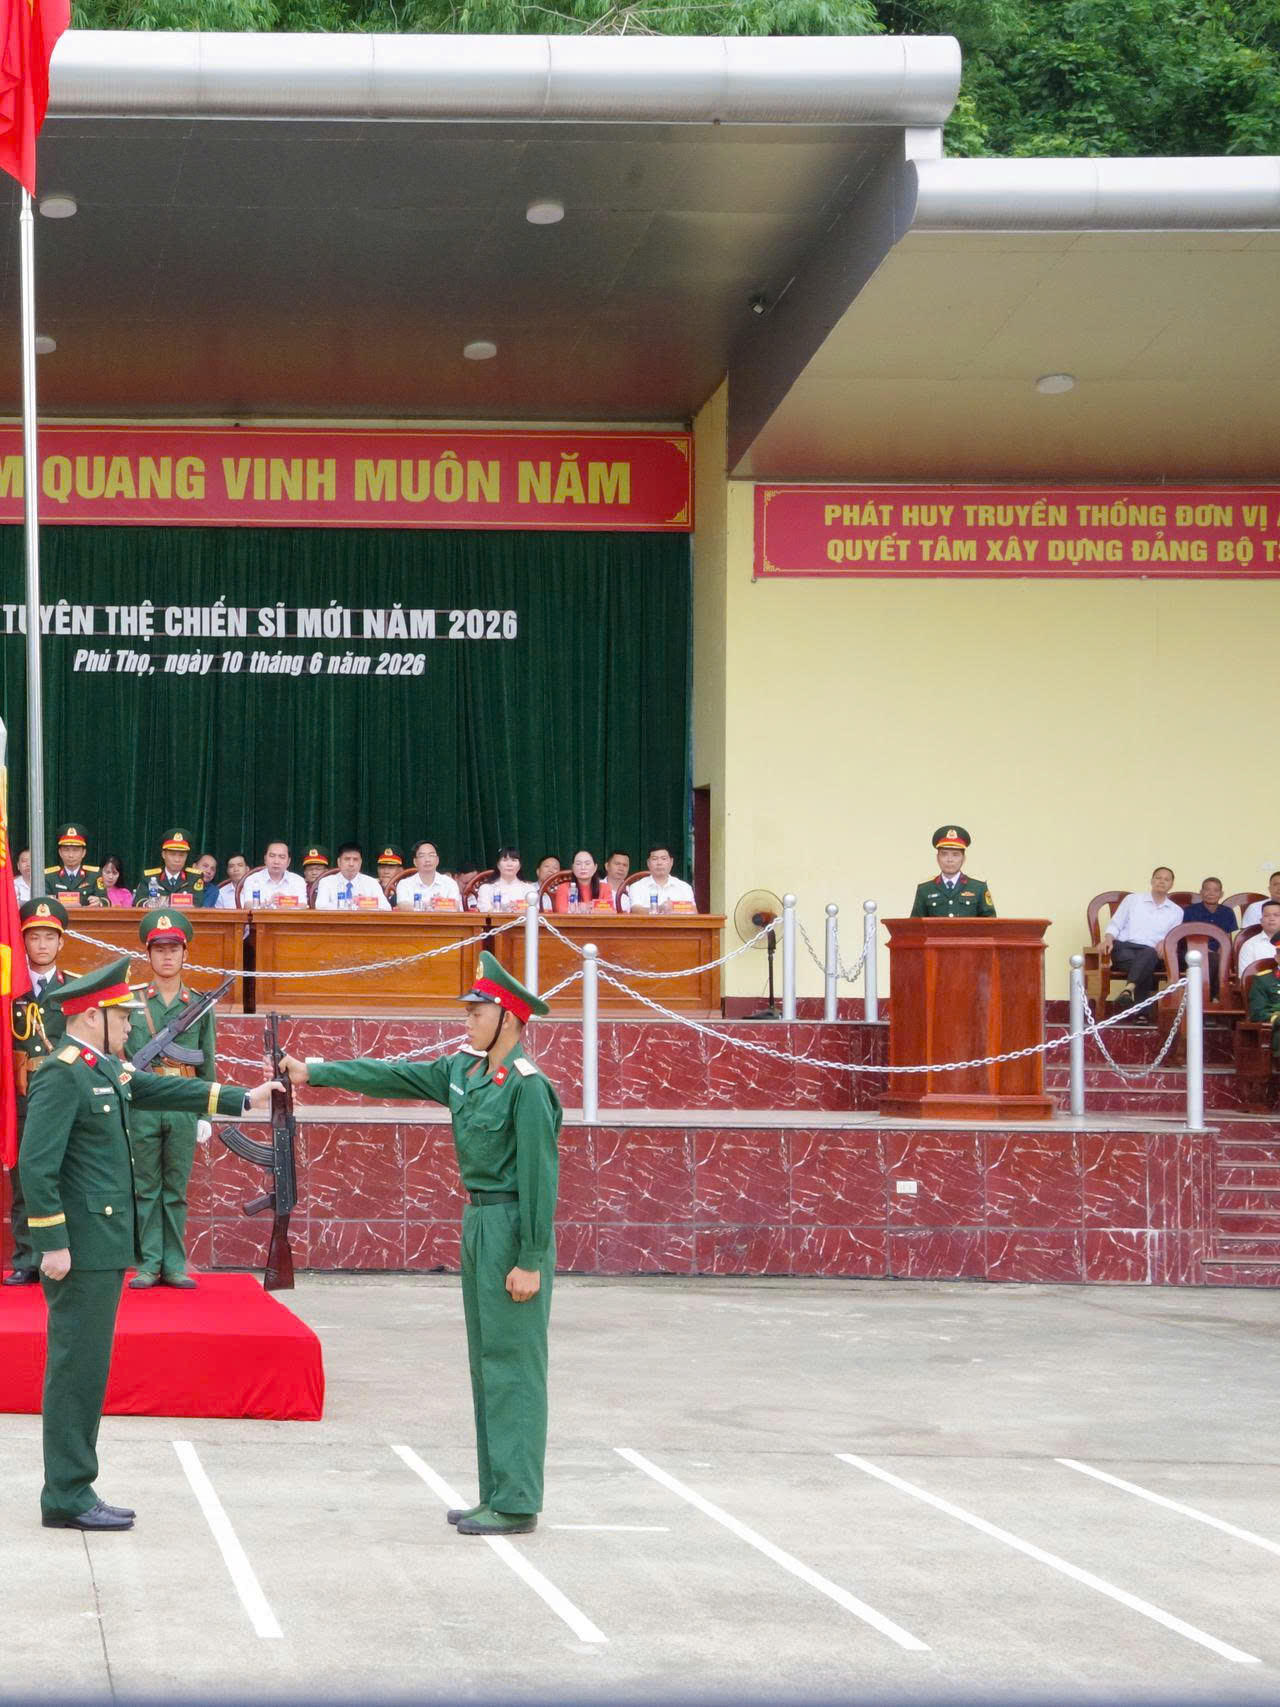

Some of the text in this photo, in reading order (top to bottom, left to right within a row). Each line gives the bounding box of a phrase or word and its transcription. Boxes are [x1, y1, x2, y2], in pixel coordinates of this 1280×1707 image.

[41, 455, 206, 505] QUANG
[221, 457, 337, 502] VINH
[354, 450, 501, 503] MUÔN
[517, 452, 630, 504] NĂM
[824, 500, 894, 527] PHÁT
[901, 504, 955, 527] HUY
[1075, 497, 1167, 527] THỐNG
[1174, 503, 1233, 527] ĐƠN
[1242, 505, 1268, 532] VỊ
[826, 530, 1280, 567] QUYẾT TÂM XÂY DỰNG ĐẢNG BỘ T
[105, 599, 155, 642] THỆ
[164, 595, 248, 637] CHIẾN
[257, 601, 286, 638] SĨ
[296, 599, 352, 639] MỚI
[362, 602, 436, 639] NĂM
[448, 608, 518, 640] 2026
[73, 648, 112, 672] Phú
[163, 648, 214, 675] ngày
[221, 650, 244, 674] 10
[249, 650, 305, 676] tháng
[309, 651, 324, 675] 6
[327, 650, 372, 675] năm
[376, 652, 426, 676] 2026
